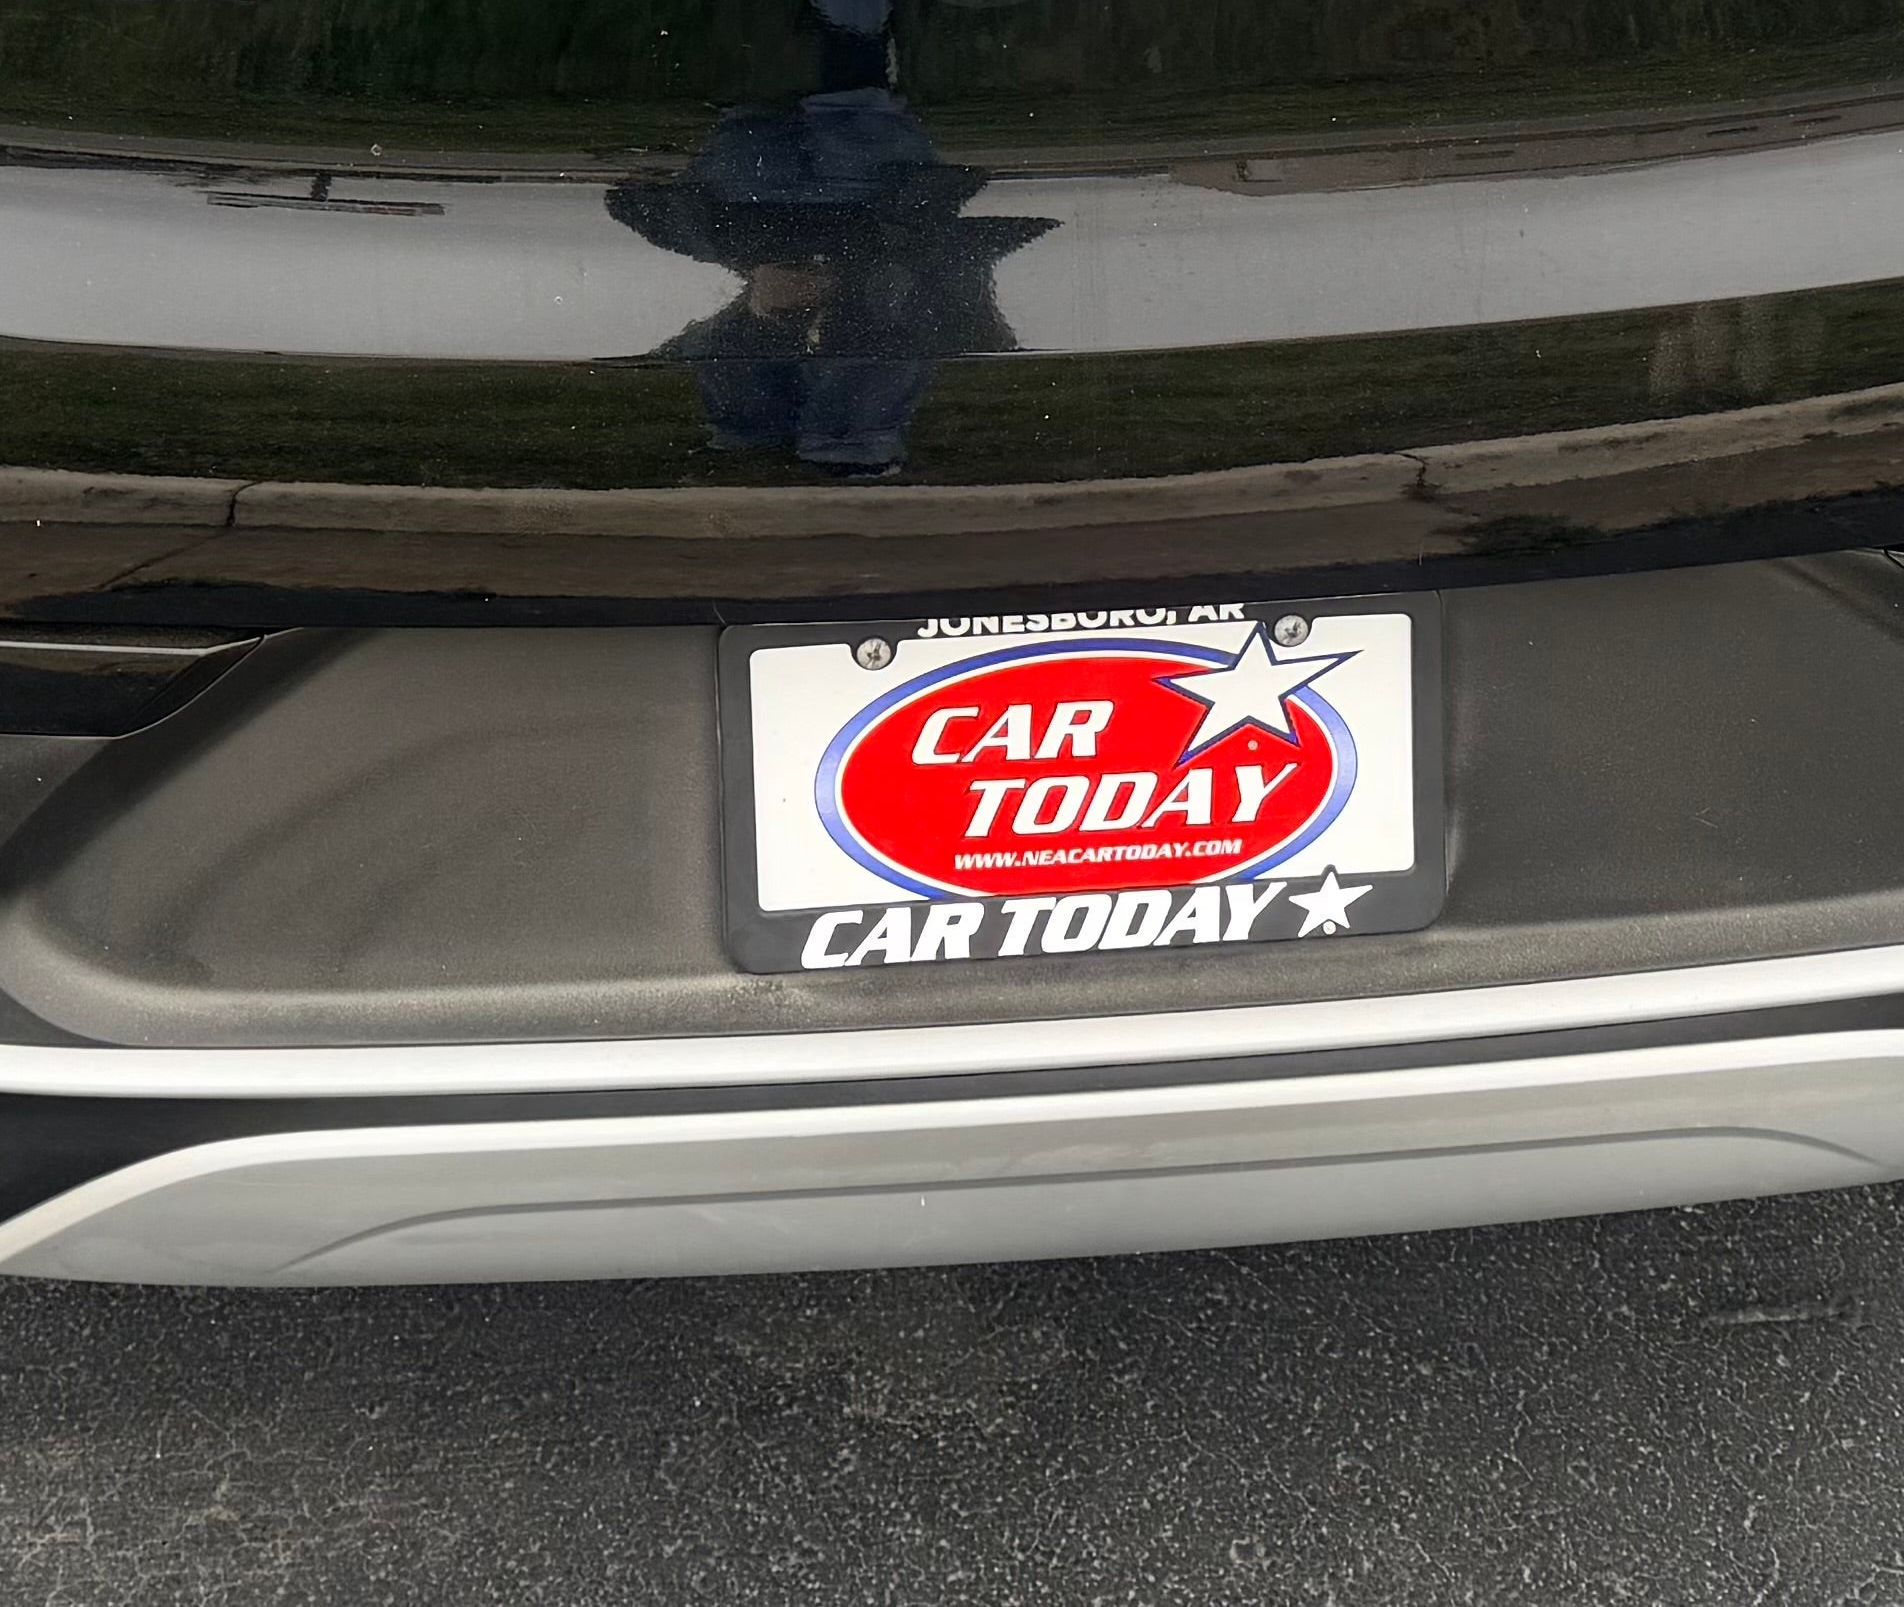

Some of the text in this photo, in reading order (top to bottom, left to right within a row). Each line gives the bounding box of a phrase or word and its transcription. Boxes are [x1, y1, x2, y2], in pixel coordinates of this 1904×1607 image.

[911, 699, 1114, 765] CAR
[963, 761, 1299, 838] TODAY
[954, 838, 1244, 870] WWW.NEACARTODAY.COM
[801, 881, 1287, 970] CAR TODAY
